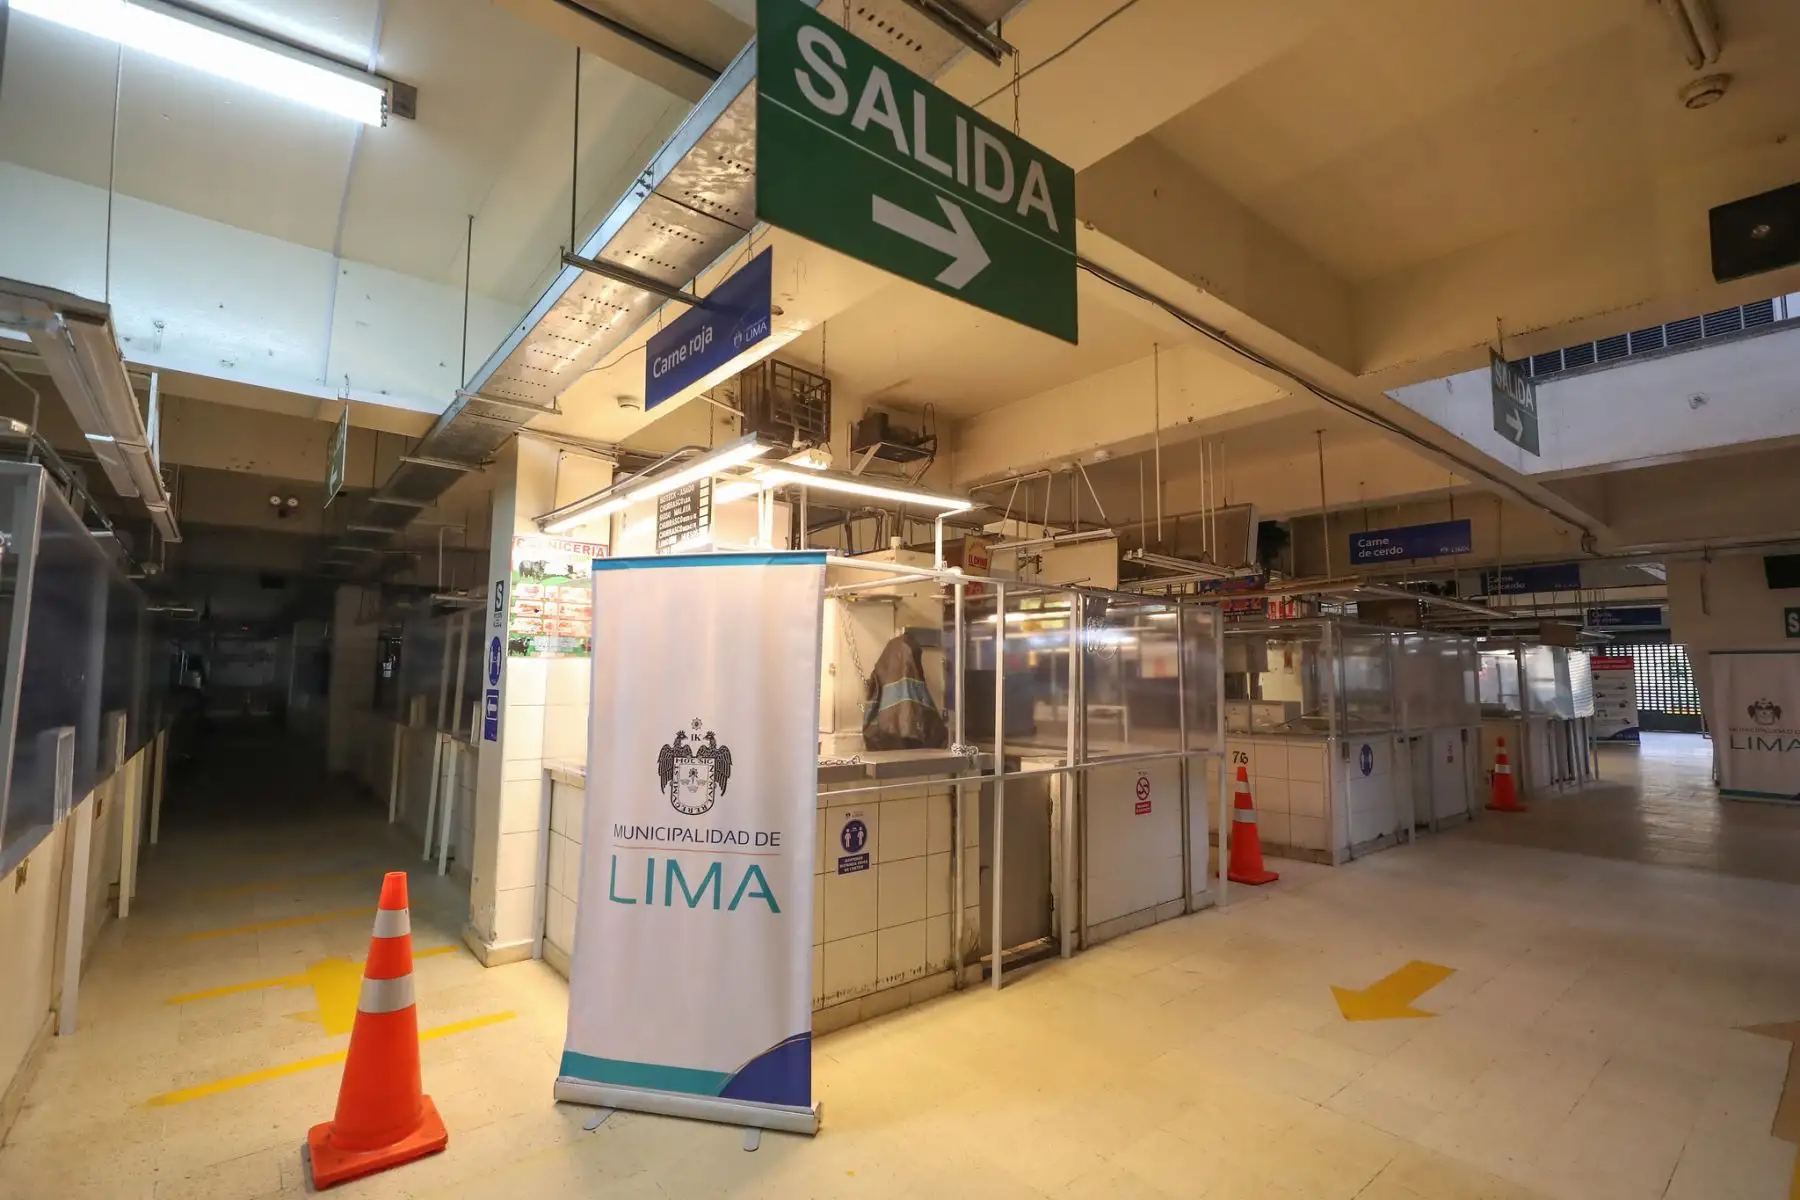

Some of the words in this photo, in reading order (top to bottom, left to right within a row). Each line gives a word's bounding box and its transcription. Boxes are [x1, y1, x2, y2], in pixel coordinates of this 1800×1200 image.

[794, 25, 1059, 234] SALIDA
[745, 321, 767, 342] LIMA
[653, 344, 687, 378] Carne
[690, 325, 713, 353] roja
[1495, 358, 1534, 412] SALIDA
[1358, 538, 1390, 548] Carne
[1358, 549, 1371, 558] de
[1374, 545, 1404, 556] cerdo
[691, 733, 702, 742] IK
[1730, 733, 1800, 752] LIMA
[613, 823, 750, 845] MUNICIPALIDAD
[754, 831, 781, 847] DE
[609, 854, 781, 914] LIMA
